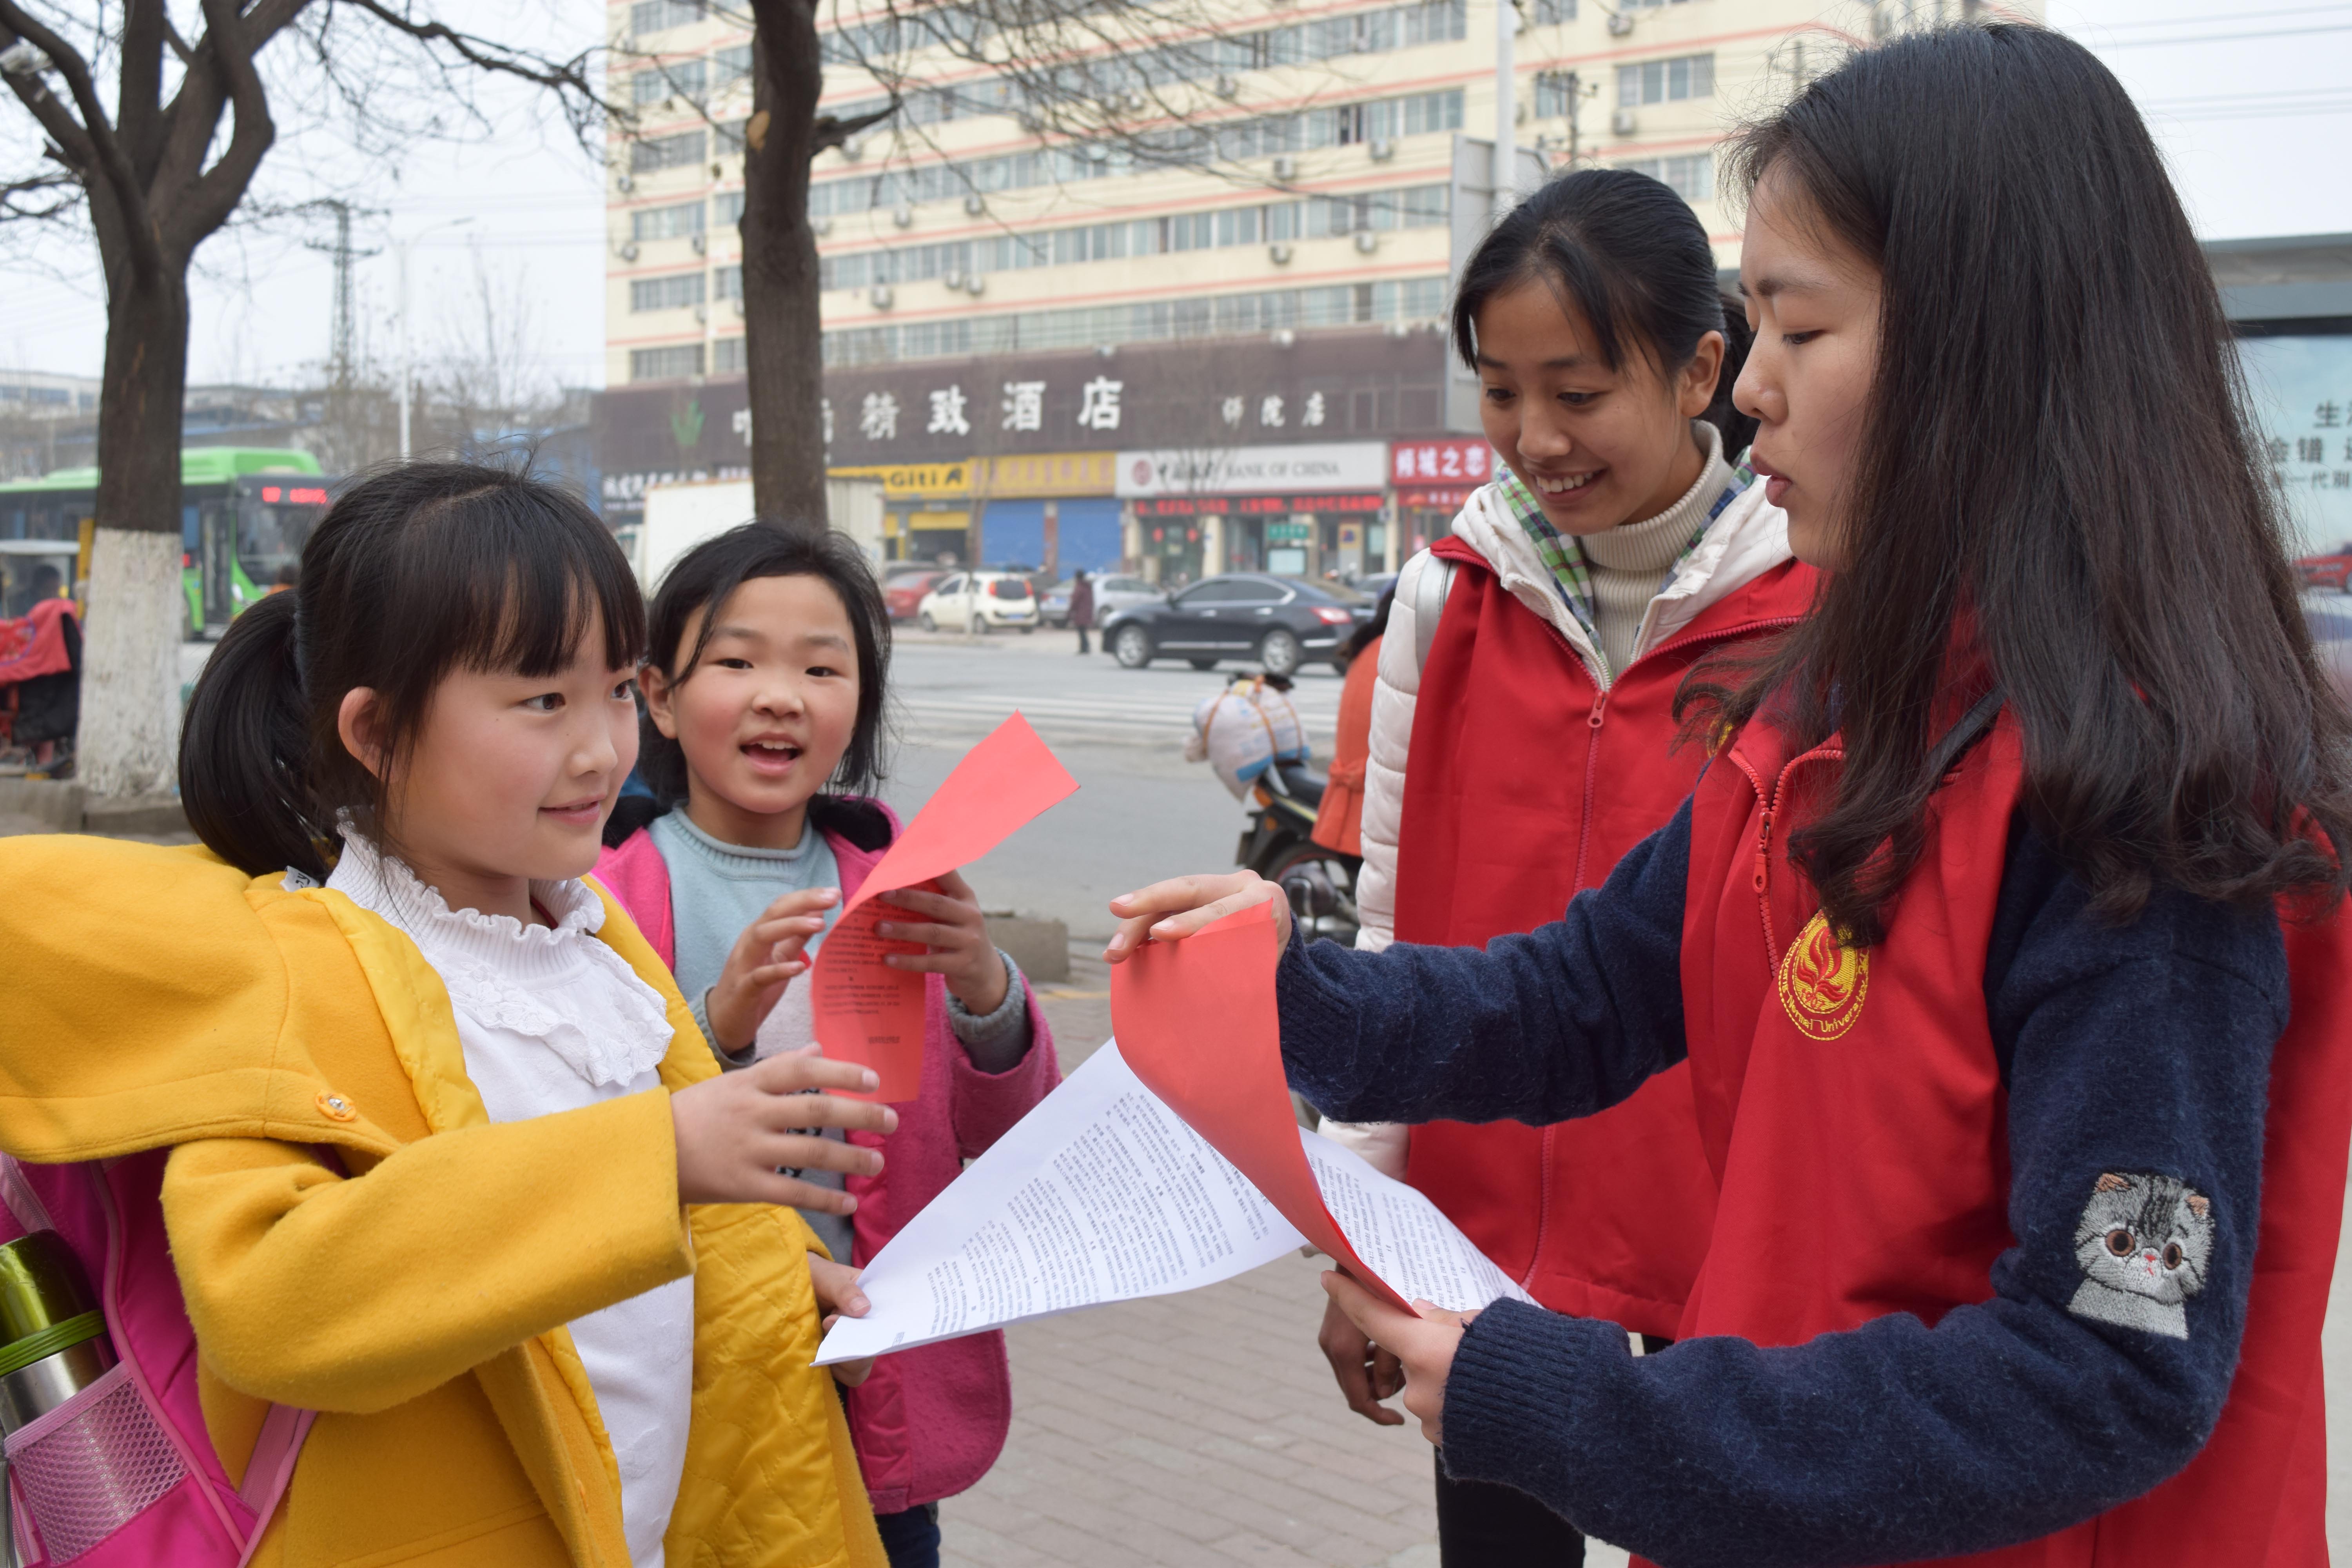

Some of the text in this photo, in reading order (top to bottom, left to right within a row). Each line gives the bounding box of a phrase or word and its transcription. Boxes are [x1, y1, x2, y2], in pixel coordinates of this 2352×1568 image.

[2314, 400, 2352, 427] 生
[1227, 461, 1340, 478] BANK OF CHINA
[1786, 995, 1813, 1031] Normal
